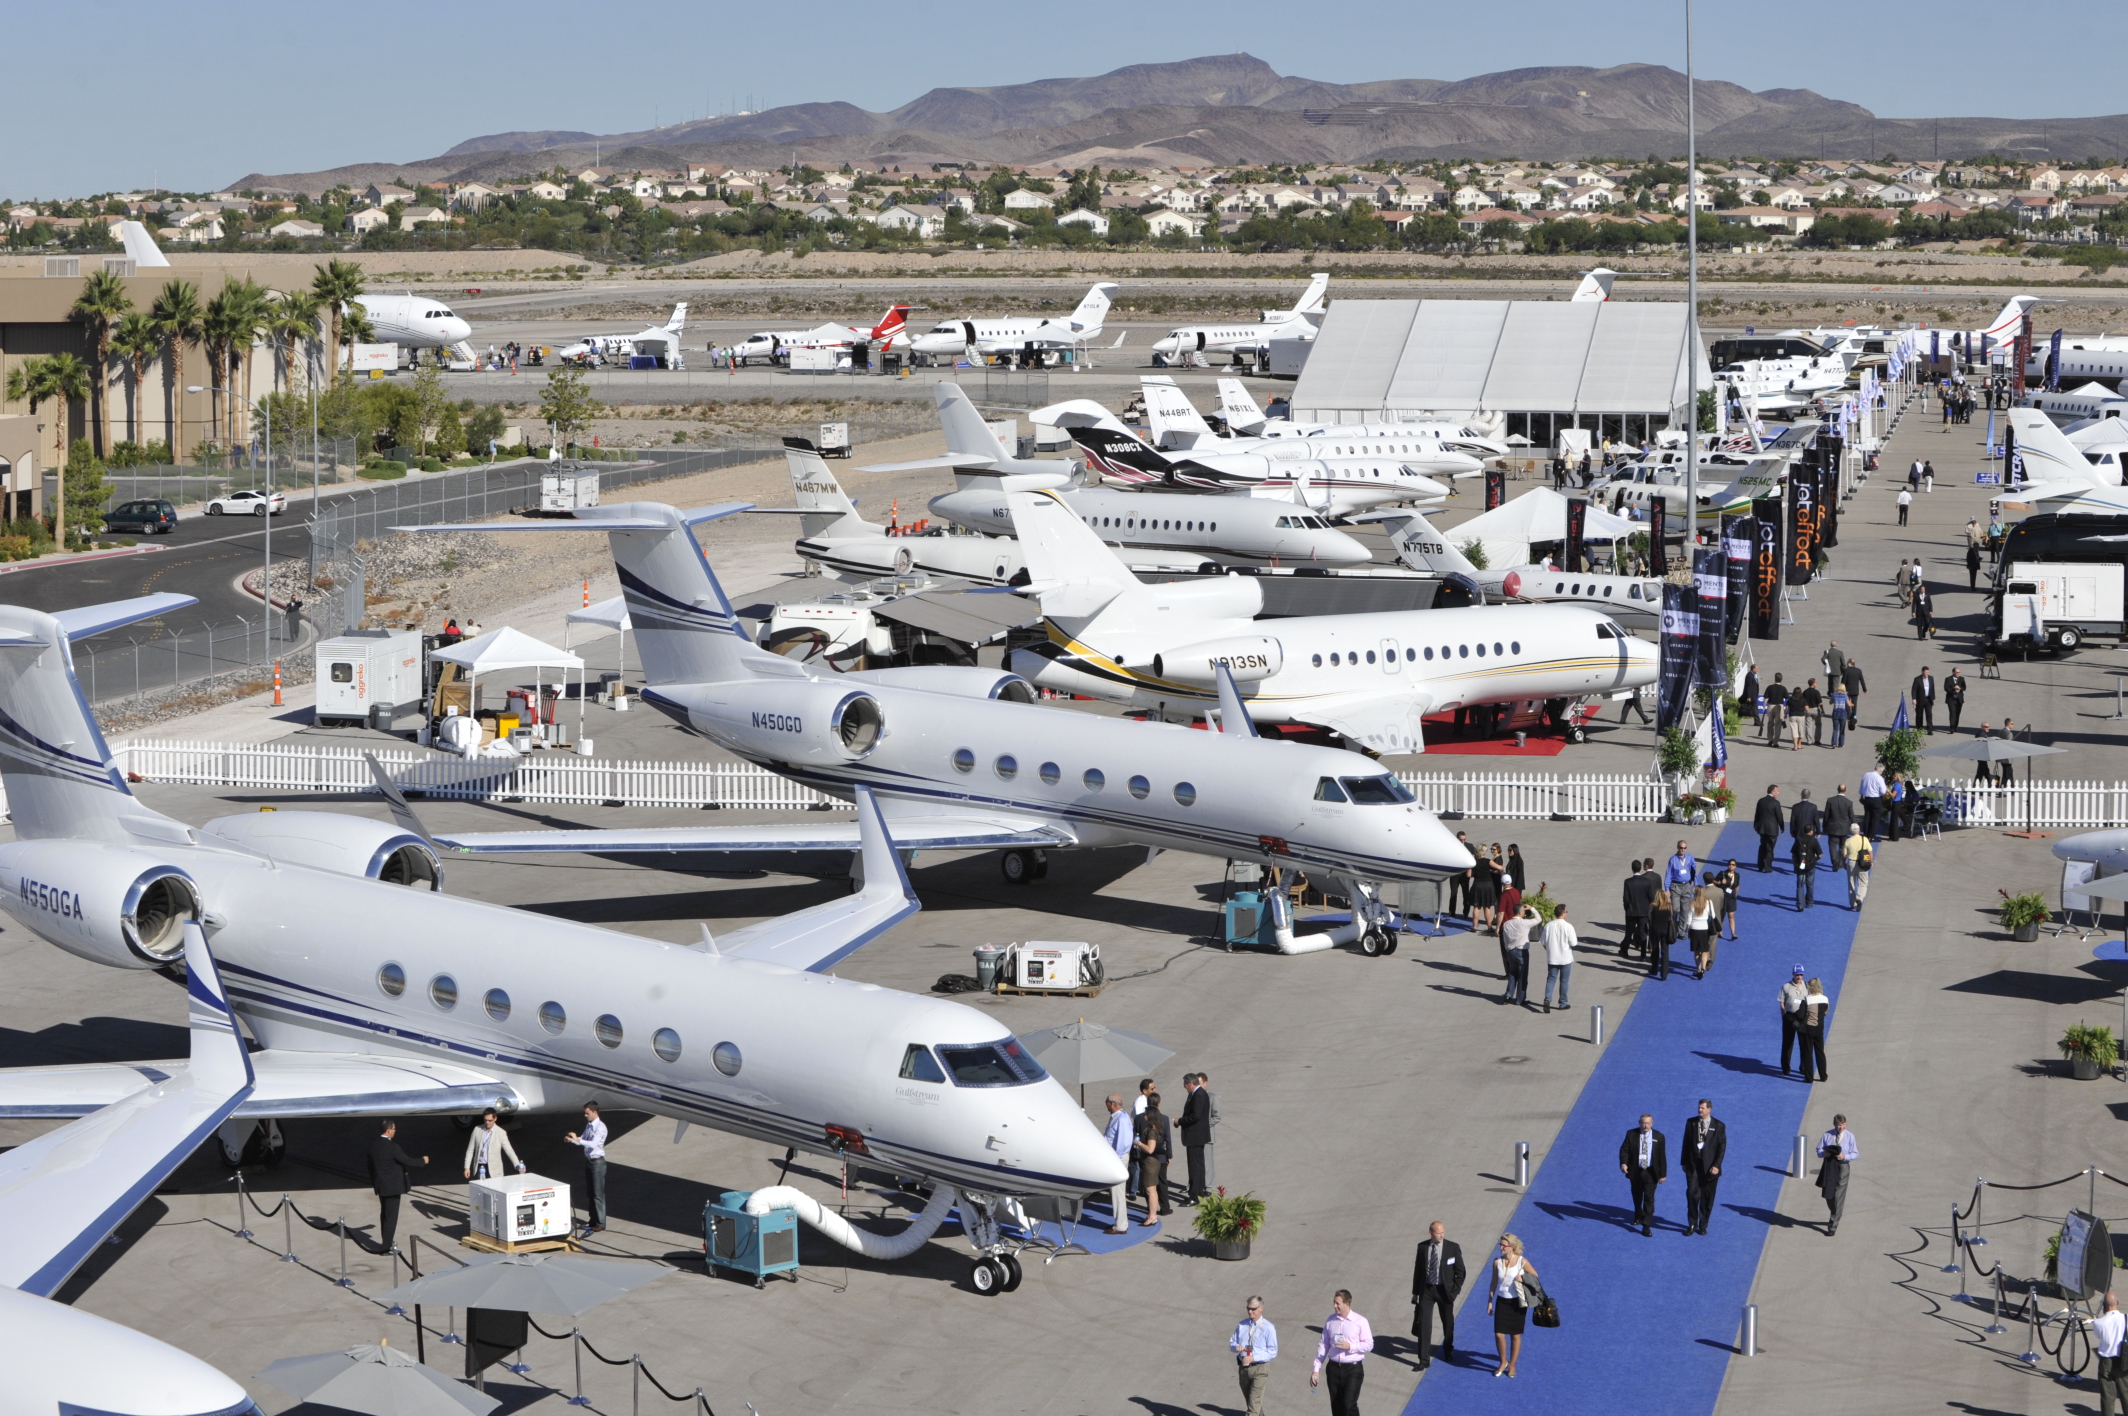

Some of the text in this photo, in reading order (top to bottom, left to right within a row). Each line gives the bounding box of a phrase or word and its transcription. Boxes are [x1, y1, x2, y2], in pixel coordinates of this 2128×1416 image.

[1159, 408, 1191, 417] N448RT
[1228, 405, 1255, 413] N61XL
[1104, 442, 1143, 453] N308CX
[1737, 476, 1773, 487] N525MC
[795, 482, 837, 494] N467MW
[1403, 541, 1444, 554] N775TB
[1704, 580, 1724, 588] MENTE
[1678, 617, 1698, 626] MENTE
[1209, 654, 1268, 671] N913SN
[356, 664, 365, 699] aggreko
[752, 711, 802, 733] N450GD
[1311, 806, 1344, 815] Gulfstream
[20, 876, 83, 921] N550GA
[896, 1086, 940, 1101] Gulfstream
